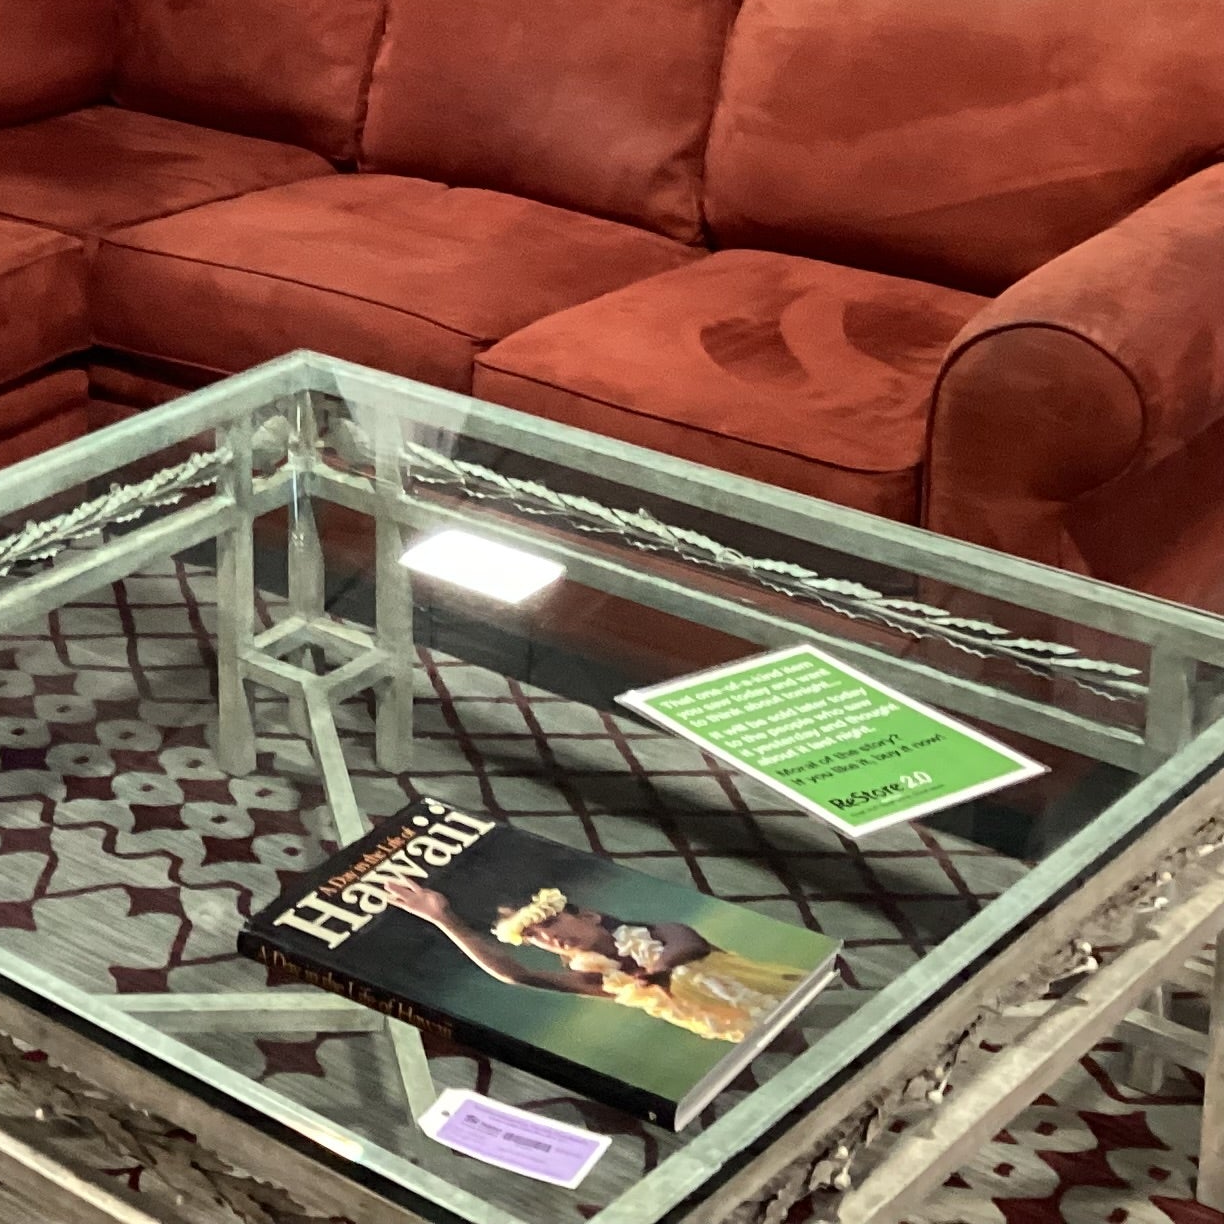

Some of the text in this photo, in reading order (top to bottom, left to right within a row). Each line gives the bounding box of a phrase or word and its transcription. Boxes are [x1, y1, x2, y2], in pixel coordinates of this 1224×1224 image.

[658, 661, 814, 709] That one-of-a-kind item
[674, 668, 831, 719] you saw today and want
[685, 716, 711, 728] to
[702, 707, 746, 722] think
[742, 694, 785, 712] about
[708, 687, 867, 739] It will be sold later today
[723, 699, 872, 748] to the people who saw
[736, 702, 900, 757] it yesterday and thought
[756, 747, 799, 766] about
[792, 744, 811, 754] it
[804, 736, 837, 750] last
[776, 734, 901, 776] Moral of the story?
[792, 778, 805, 786] If
[808, 772, 833, 782] you
[830, 764, 859, 773] like
[870, 750, 900, 760] buy
[829, 782, 904, 810] ReStore
[900, 771, 932, 788] 2.0
[273, 804, 496, 950] Hawaii
[319, 886, 337, 897] A
[328, 871, 360, 889] Day
